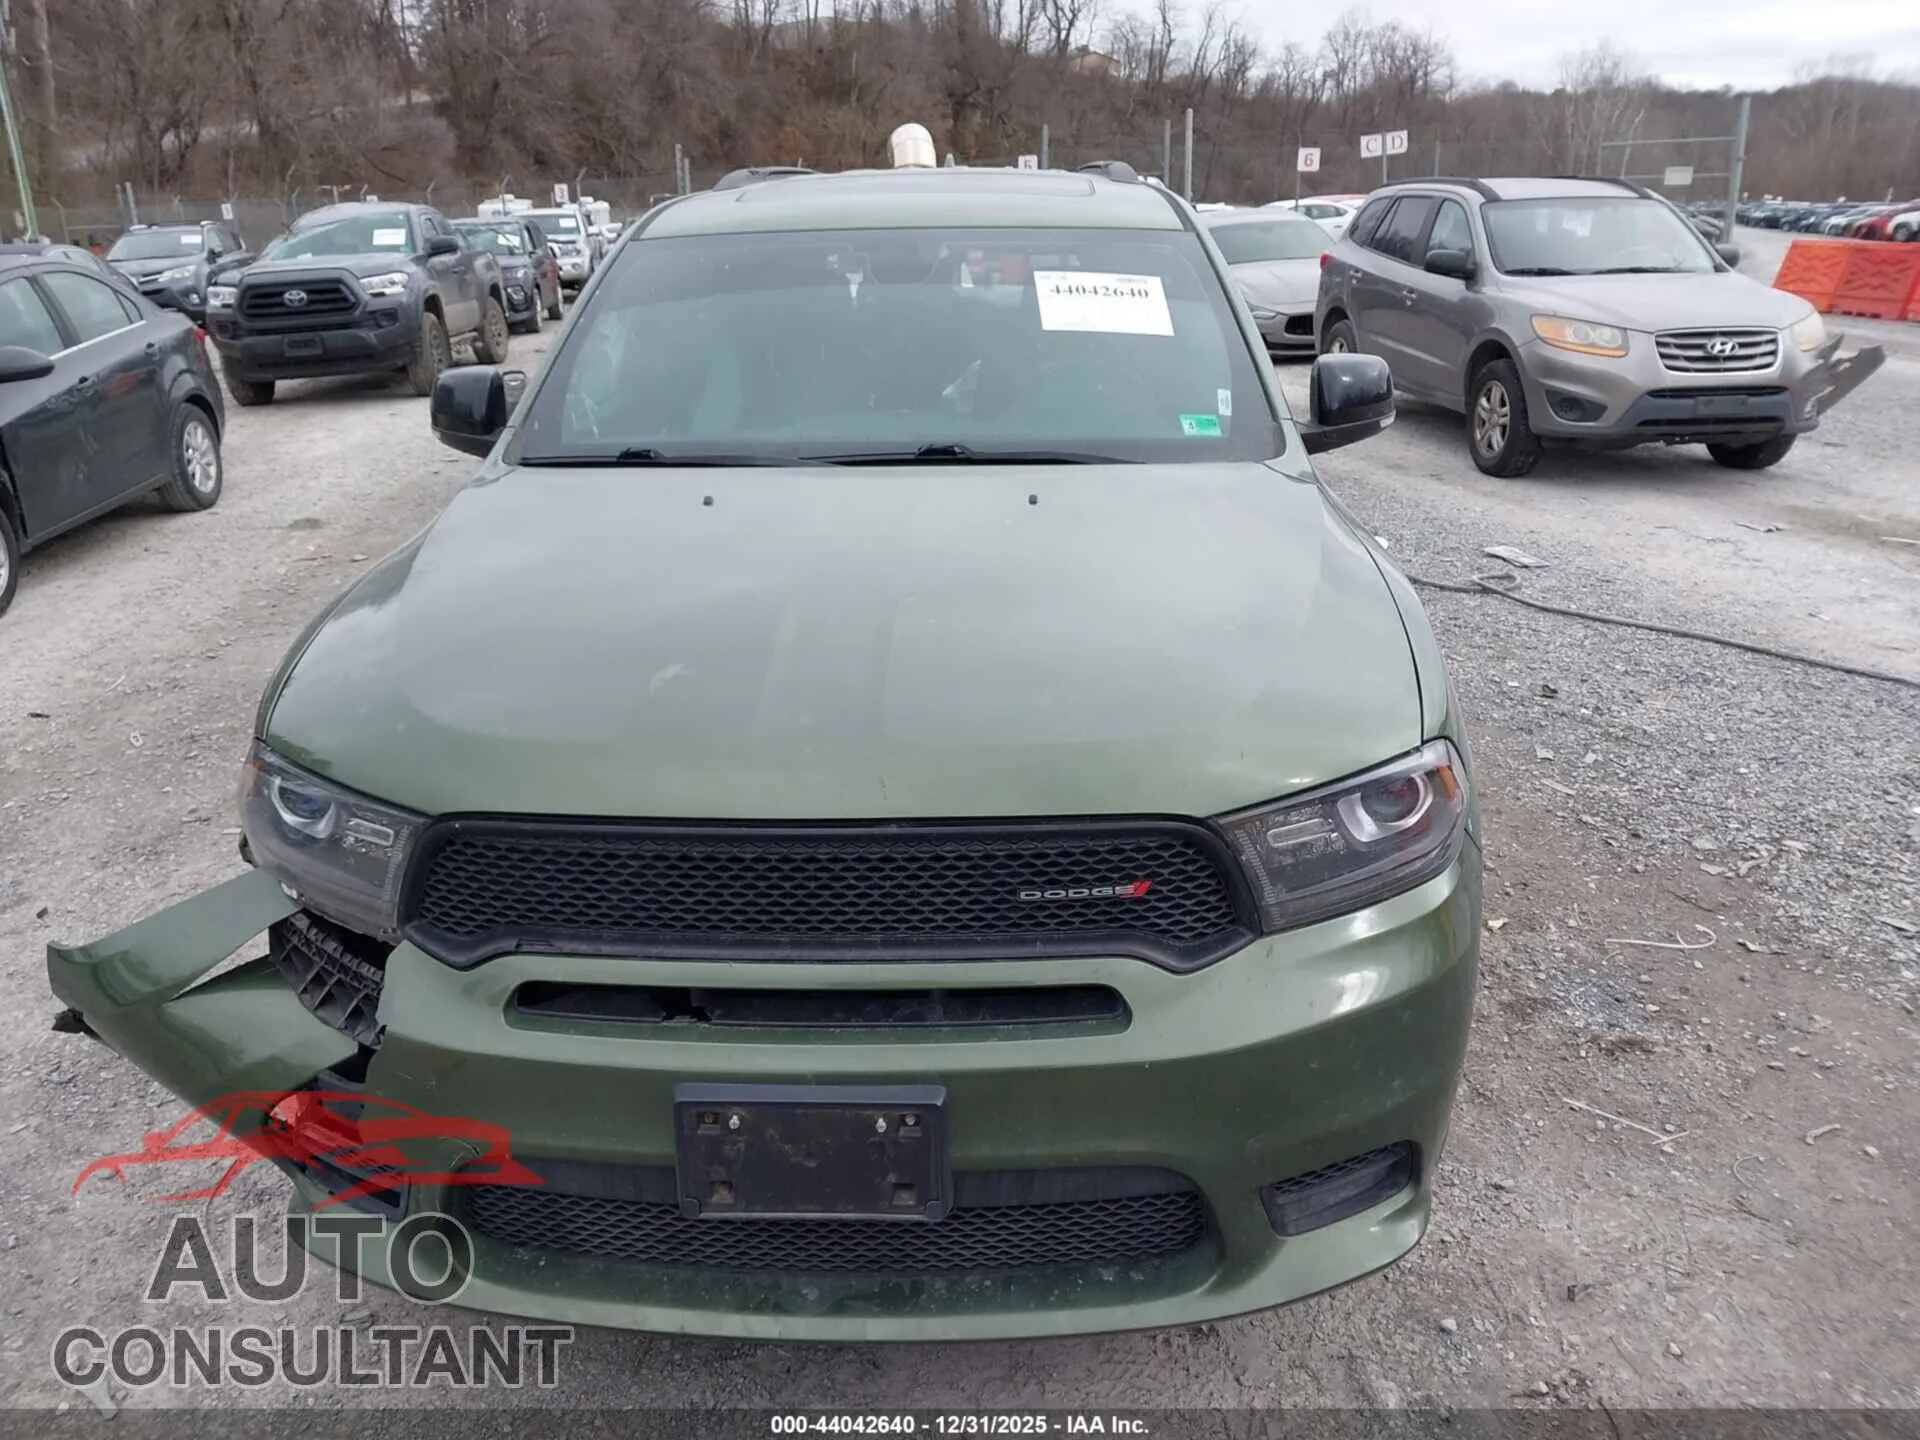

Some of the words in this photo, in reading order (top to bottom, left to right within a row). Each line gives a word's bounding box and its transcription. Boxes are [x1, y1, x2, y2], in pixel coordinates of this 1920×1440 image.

[1366, 138, 1378, 153] C
[1391, 135, 1404, 150] D
[1304, 152, 1314, 167] 6
[1049, 284, 1149, 298] 44042640
[1019, 884, 1136, 899] DODGE
